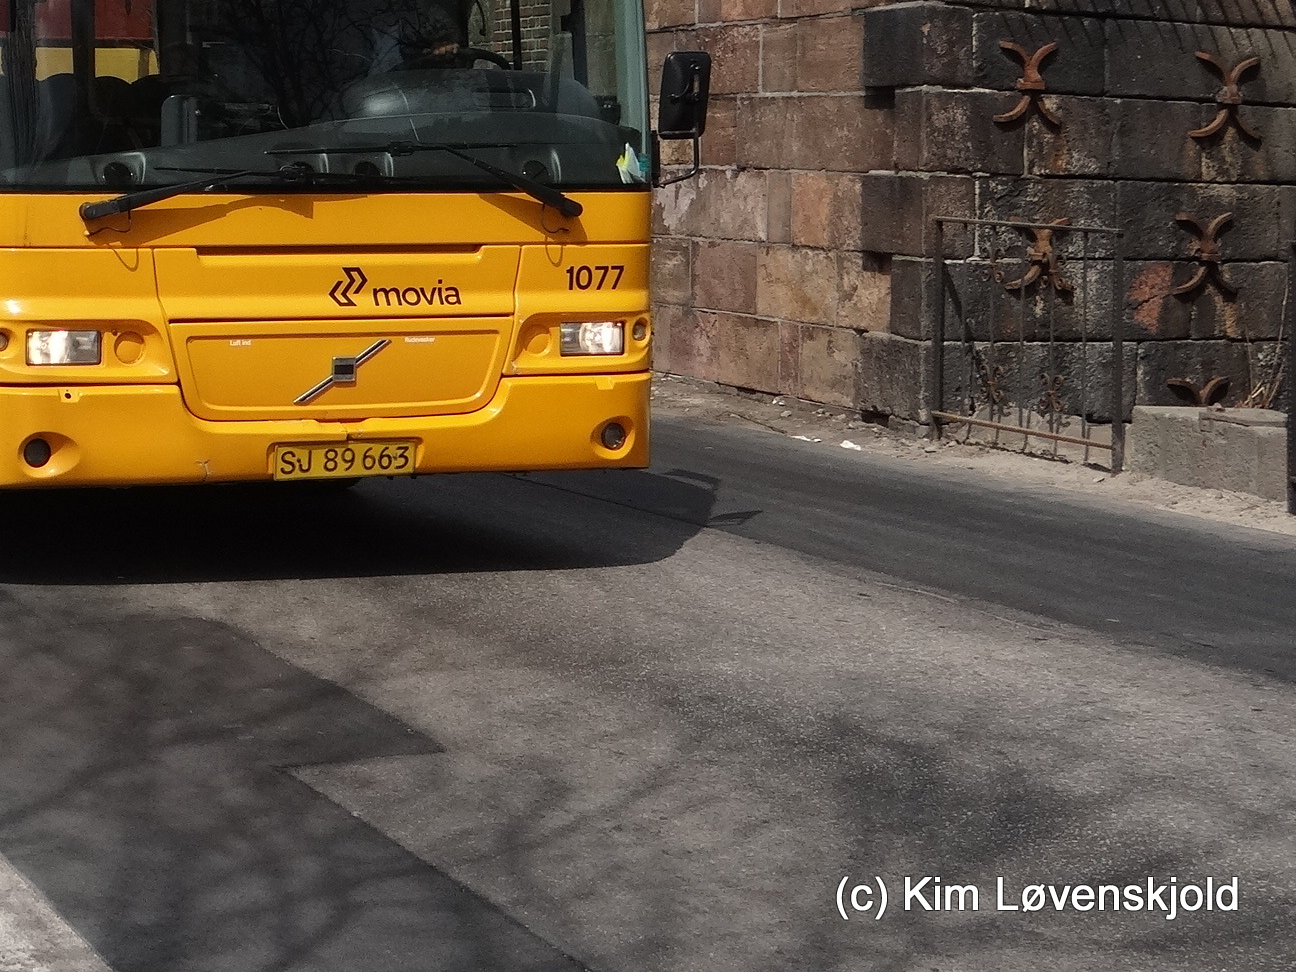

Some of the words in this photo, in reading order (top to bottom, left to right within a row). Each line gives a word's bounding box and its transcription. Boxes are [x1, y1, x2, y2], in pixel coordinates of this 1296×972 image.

[565, 265, 625, 291] 1077
[372, 279, 462, 307] movia
[280, 450, 312, 475] SJ
[323, 448, 356, 472] 89
[362, 446, 410, 471] 663
